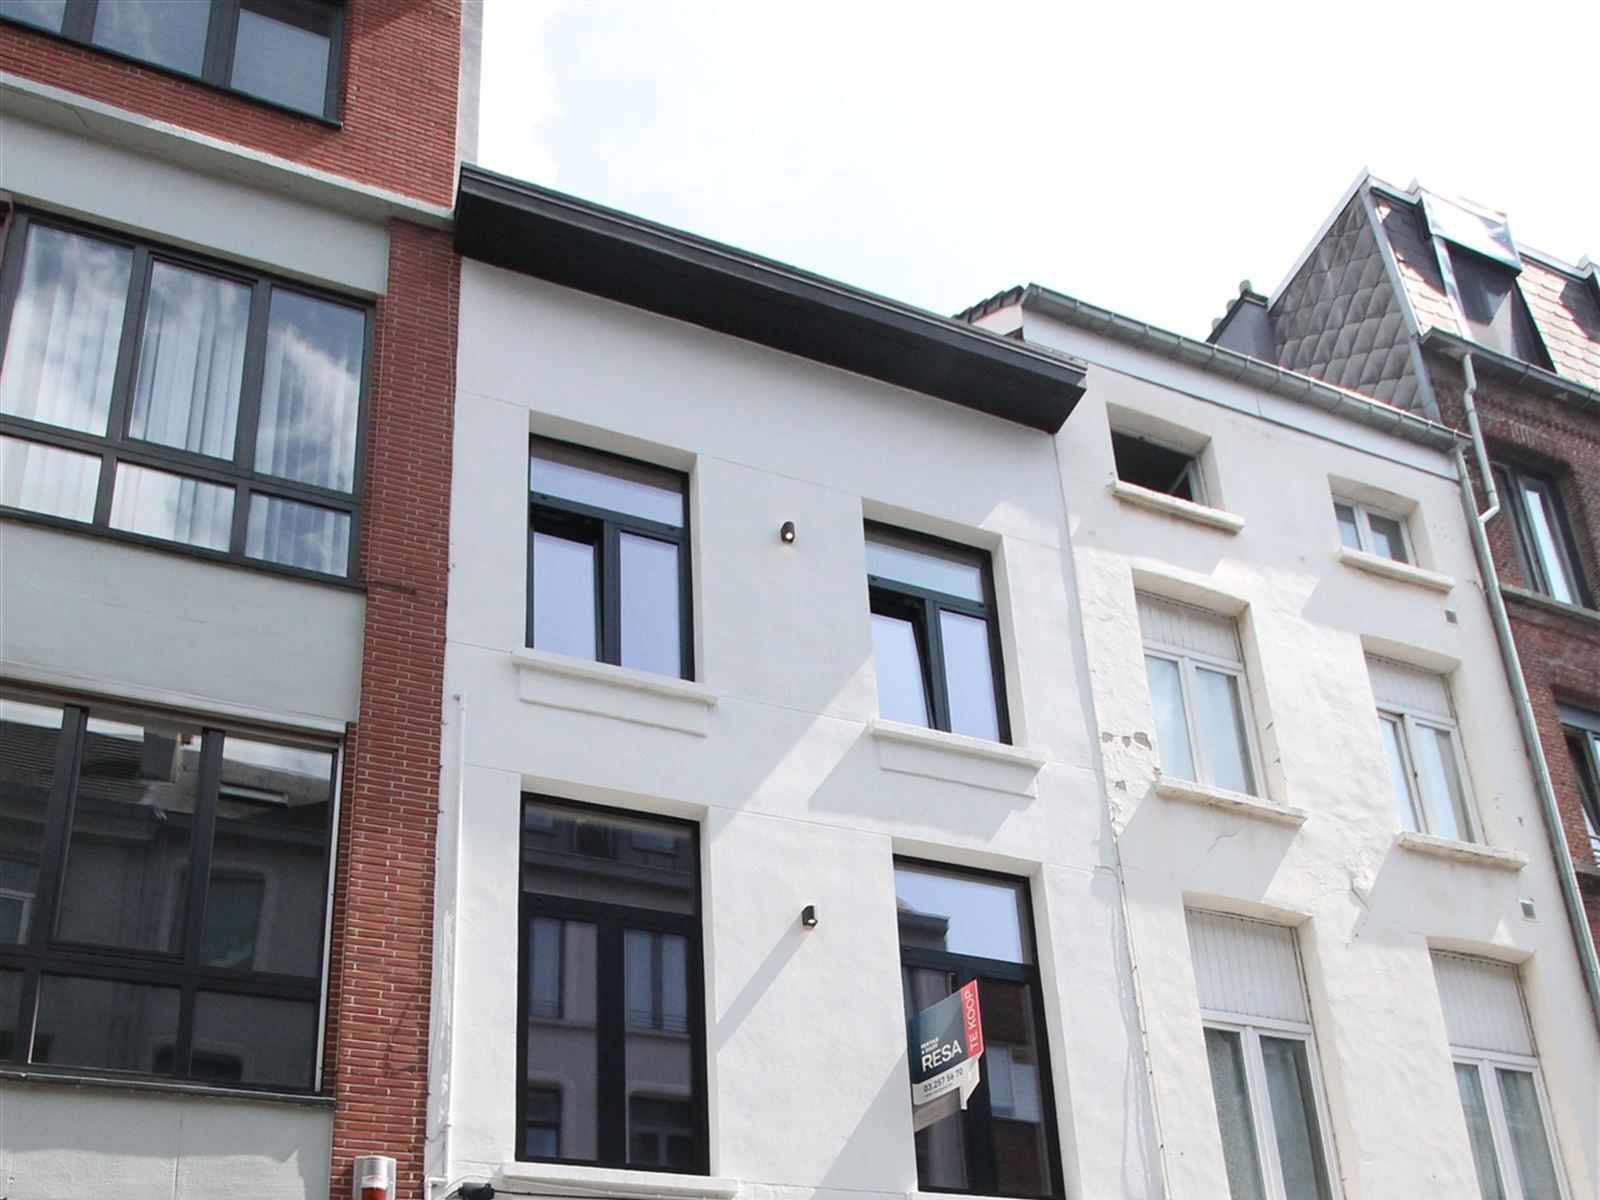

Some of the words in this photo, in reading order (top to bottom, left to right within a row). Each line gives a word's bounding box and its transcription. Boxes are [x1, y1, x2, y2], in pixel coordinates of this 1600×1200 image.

[964, 989, 977, 1030] KOOP
[921, 1039, 962, 1072] RESA
[969, 1030, 979, 1052] TE
